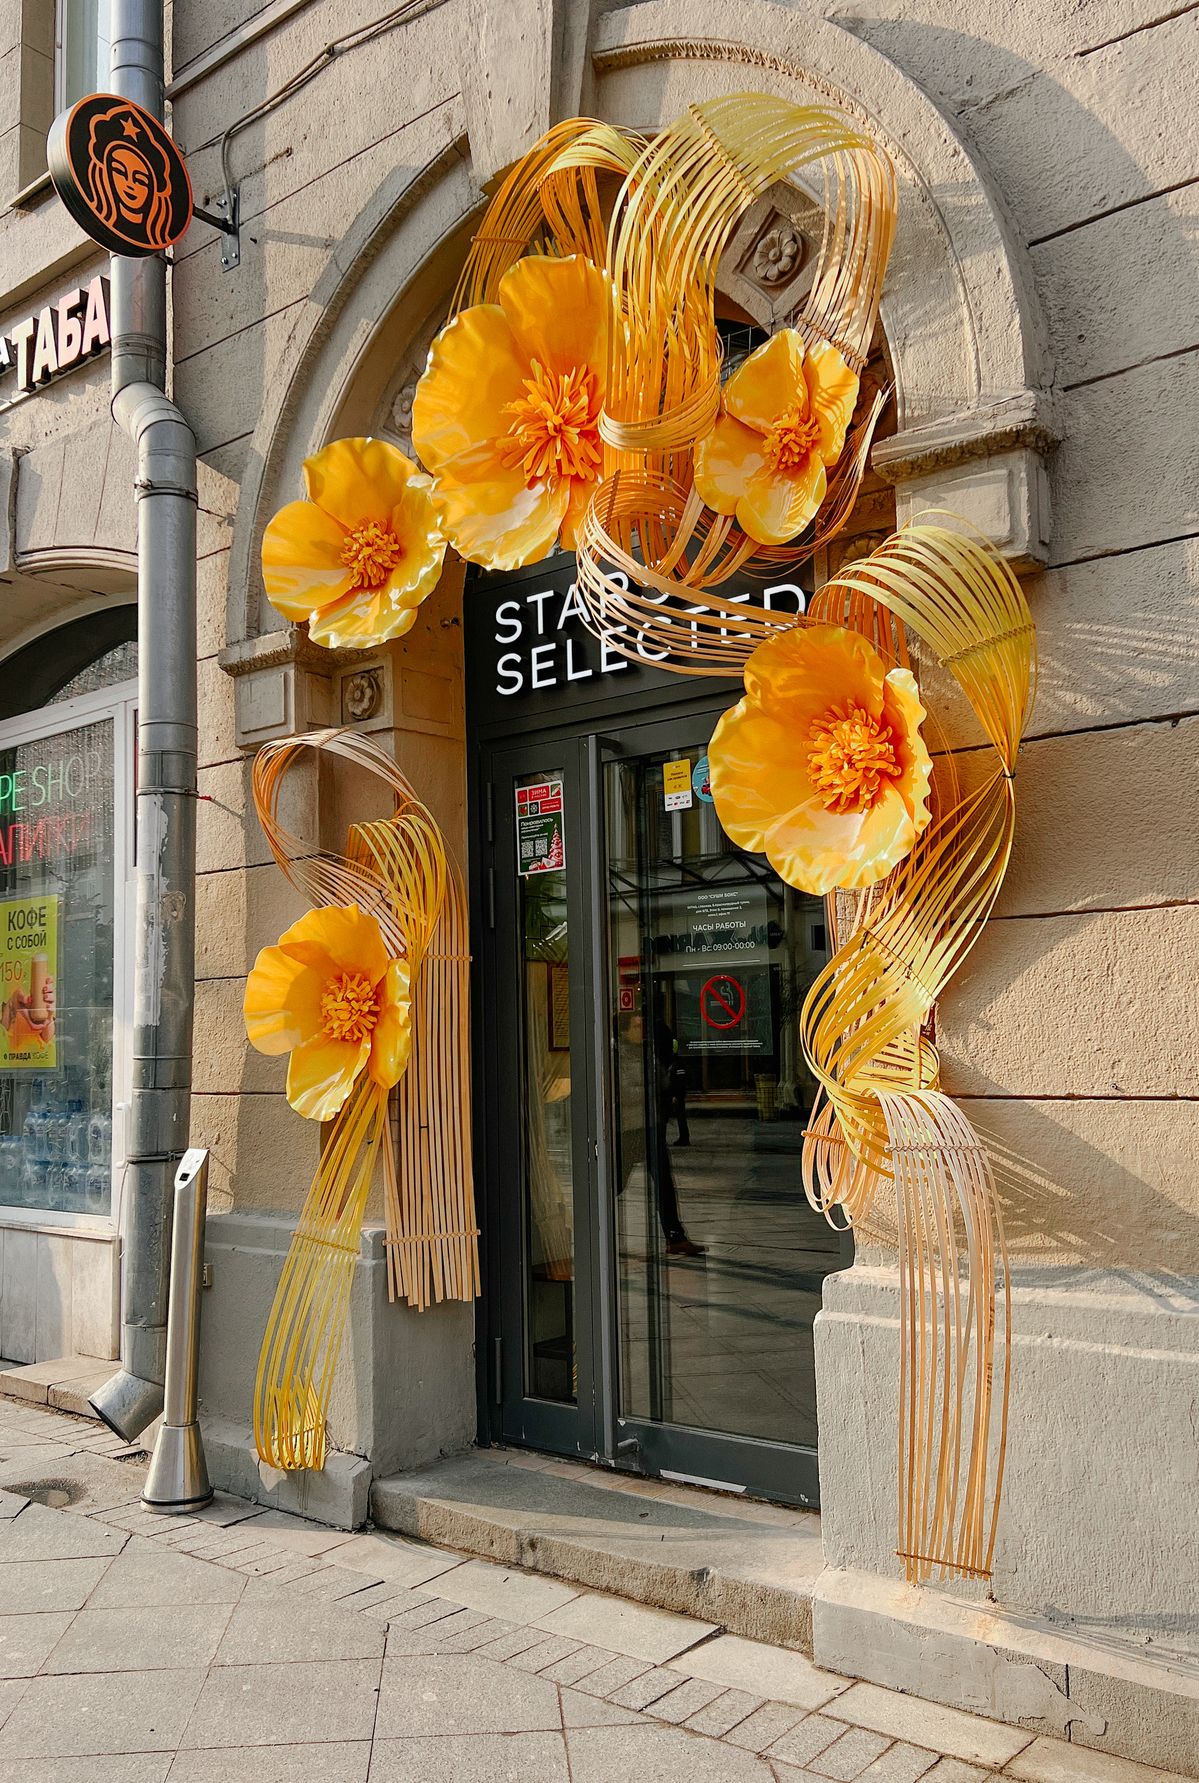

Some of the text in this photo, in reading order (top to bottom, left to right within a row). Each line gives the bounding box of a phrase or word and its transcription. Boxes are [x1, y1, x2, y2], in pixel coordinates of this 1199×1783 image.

[496, 583, 806, 696] SELECTED
[32, 751, 100, 806] SHOP
[8, 906, 47, 932] КОФЕ
[692, 920, 746, 932] ЧАСЫ РАБОТЫ
[7, 929, 47, 951] С СОБОЙ
[685, 945, 696, 953] Пн
[9, 1052, 32, 1061] ПРАВДА
